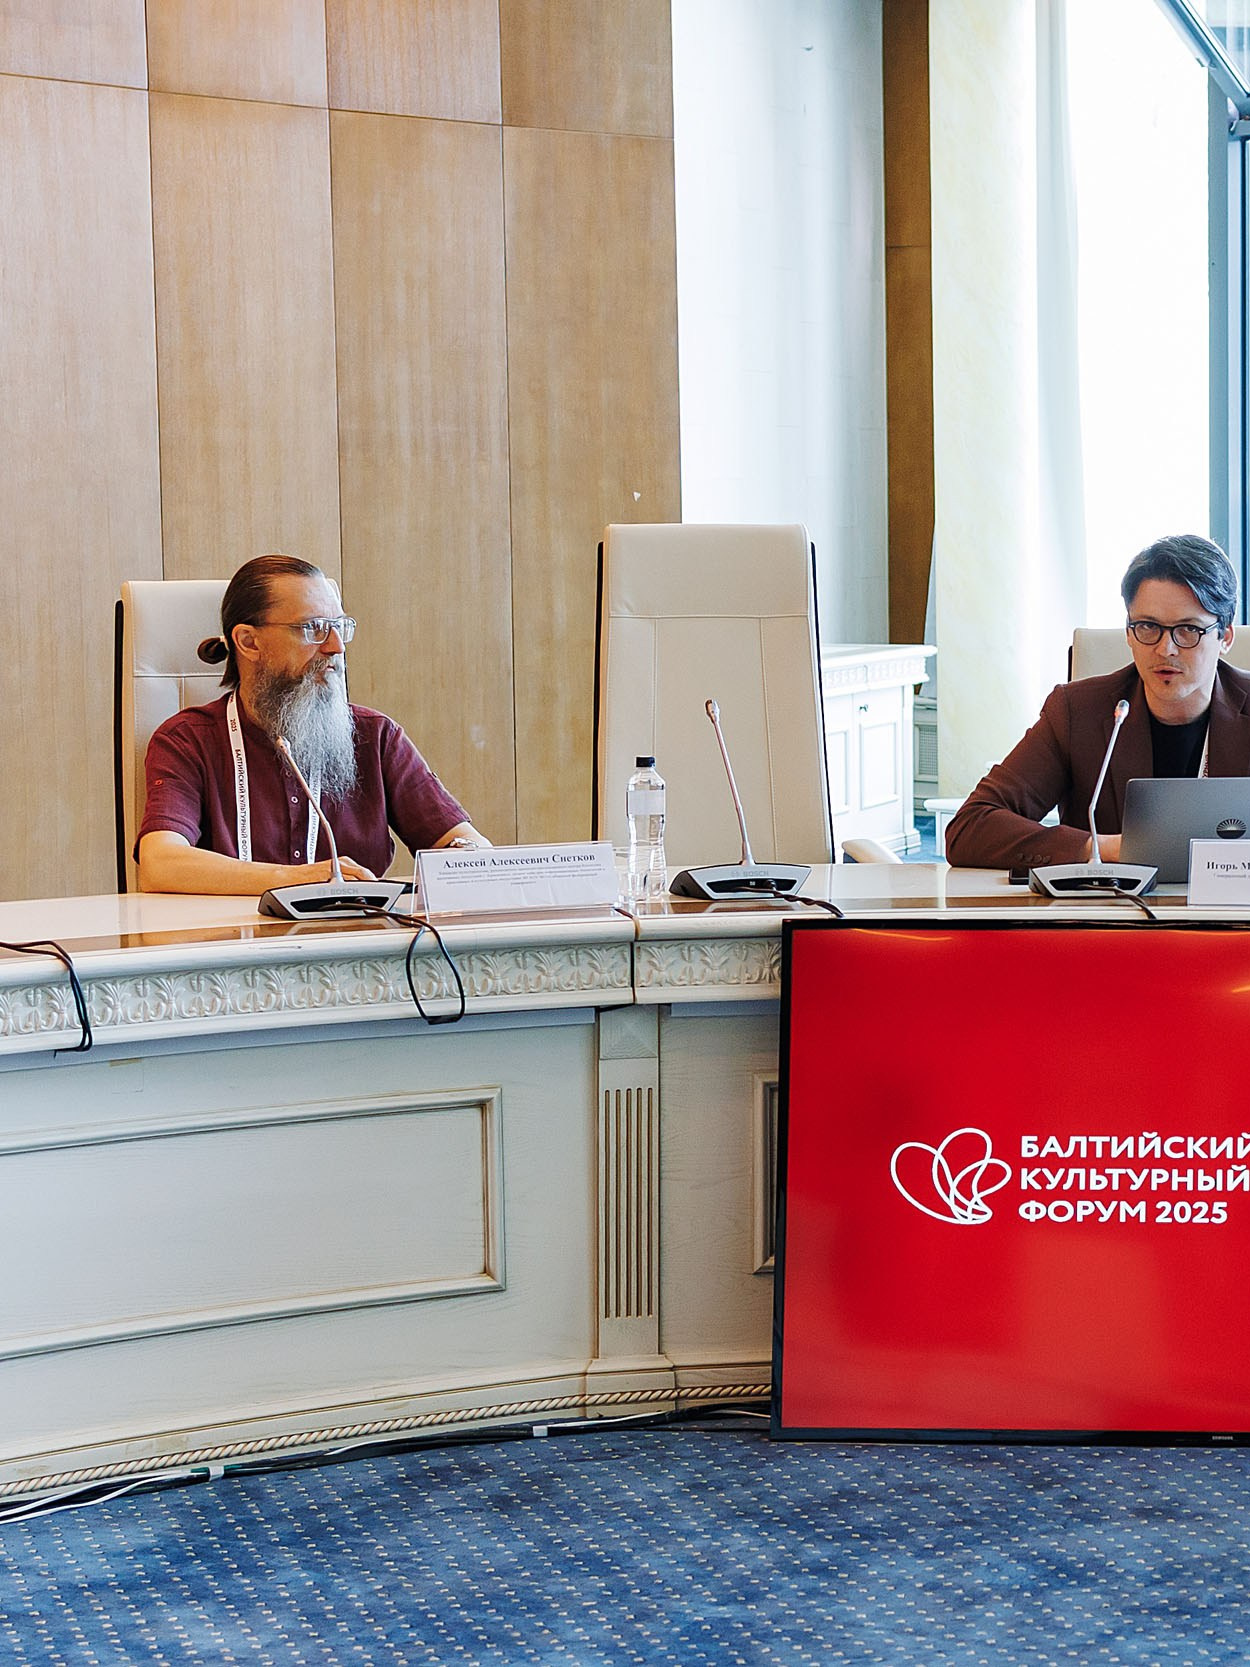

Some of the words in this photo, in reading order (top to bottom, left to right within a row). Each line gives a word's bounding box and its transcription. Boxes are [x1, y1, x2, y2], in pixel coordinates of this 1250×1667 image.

[235, 749, 247, 793] БАЛТИЙСКИЙ
[238, 795, 249, 838] КУЛЬТУРНЫЙ
[443, 858, 486, 869] Алексей
[490, 857, 548, 866] Алексеевич
[552, 853, 596, 864] Снетков
[1207, 861, 1238, 872] Игорь
[330, 887, 359, 895] BOSCH
[1020, 1165, 1250, 1192] КУЛЬТУРНЫЙ
[1018, 1200, 1147, 1223] ФОРУМ
[1155, 1201, 1228, 1224] 2025
